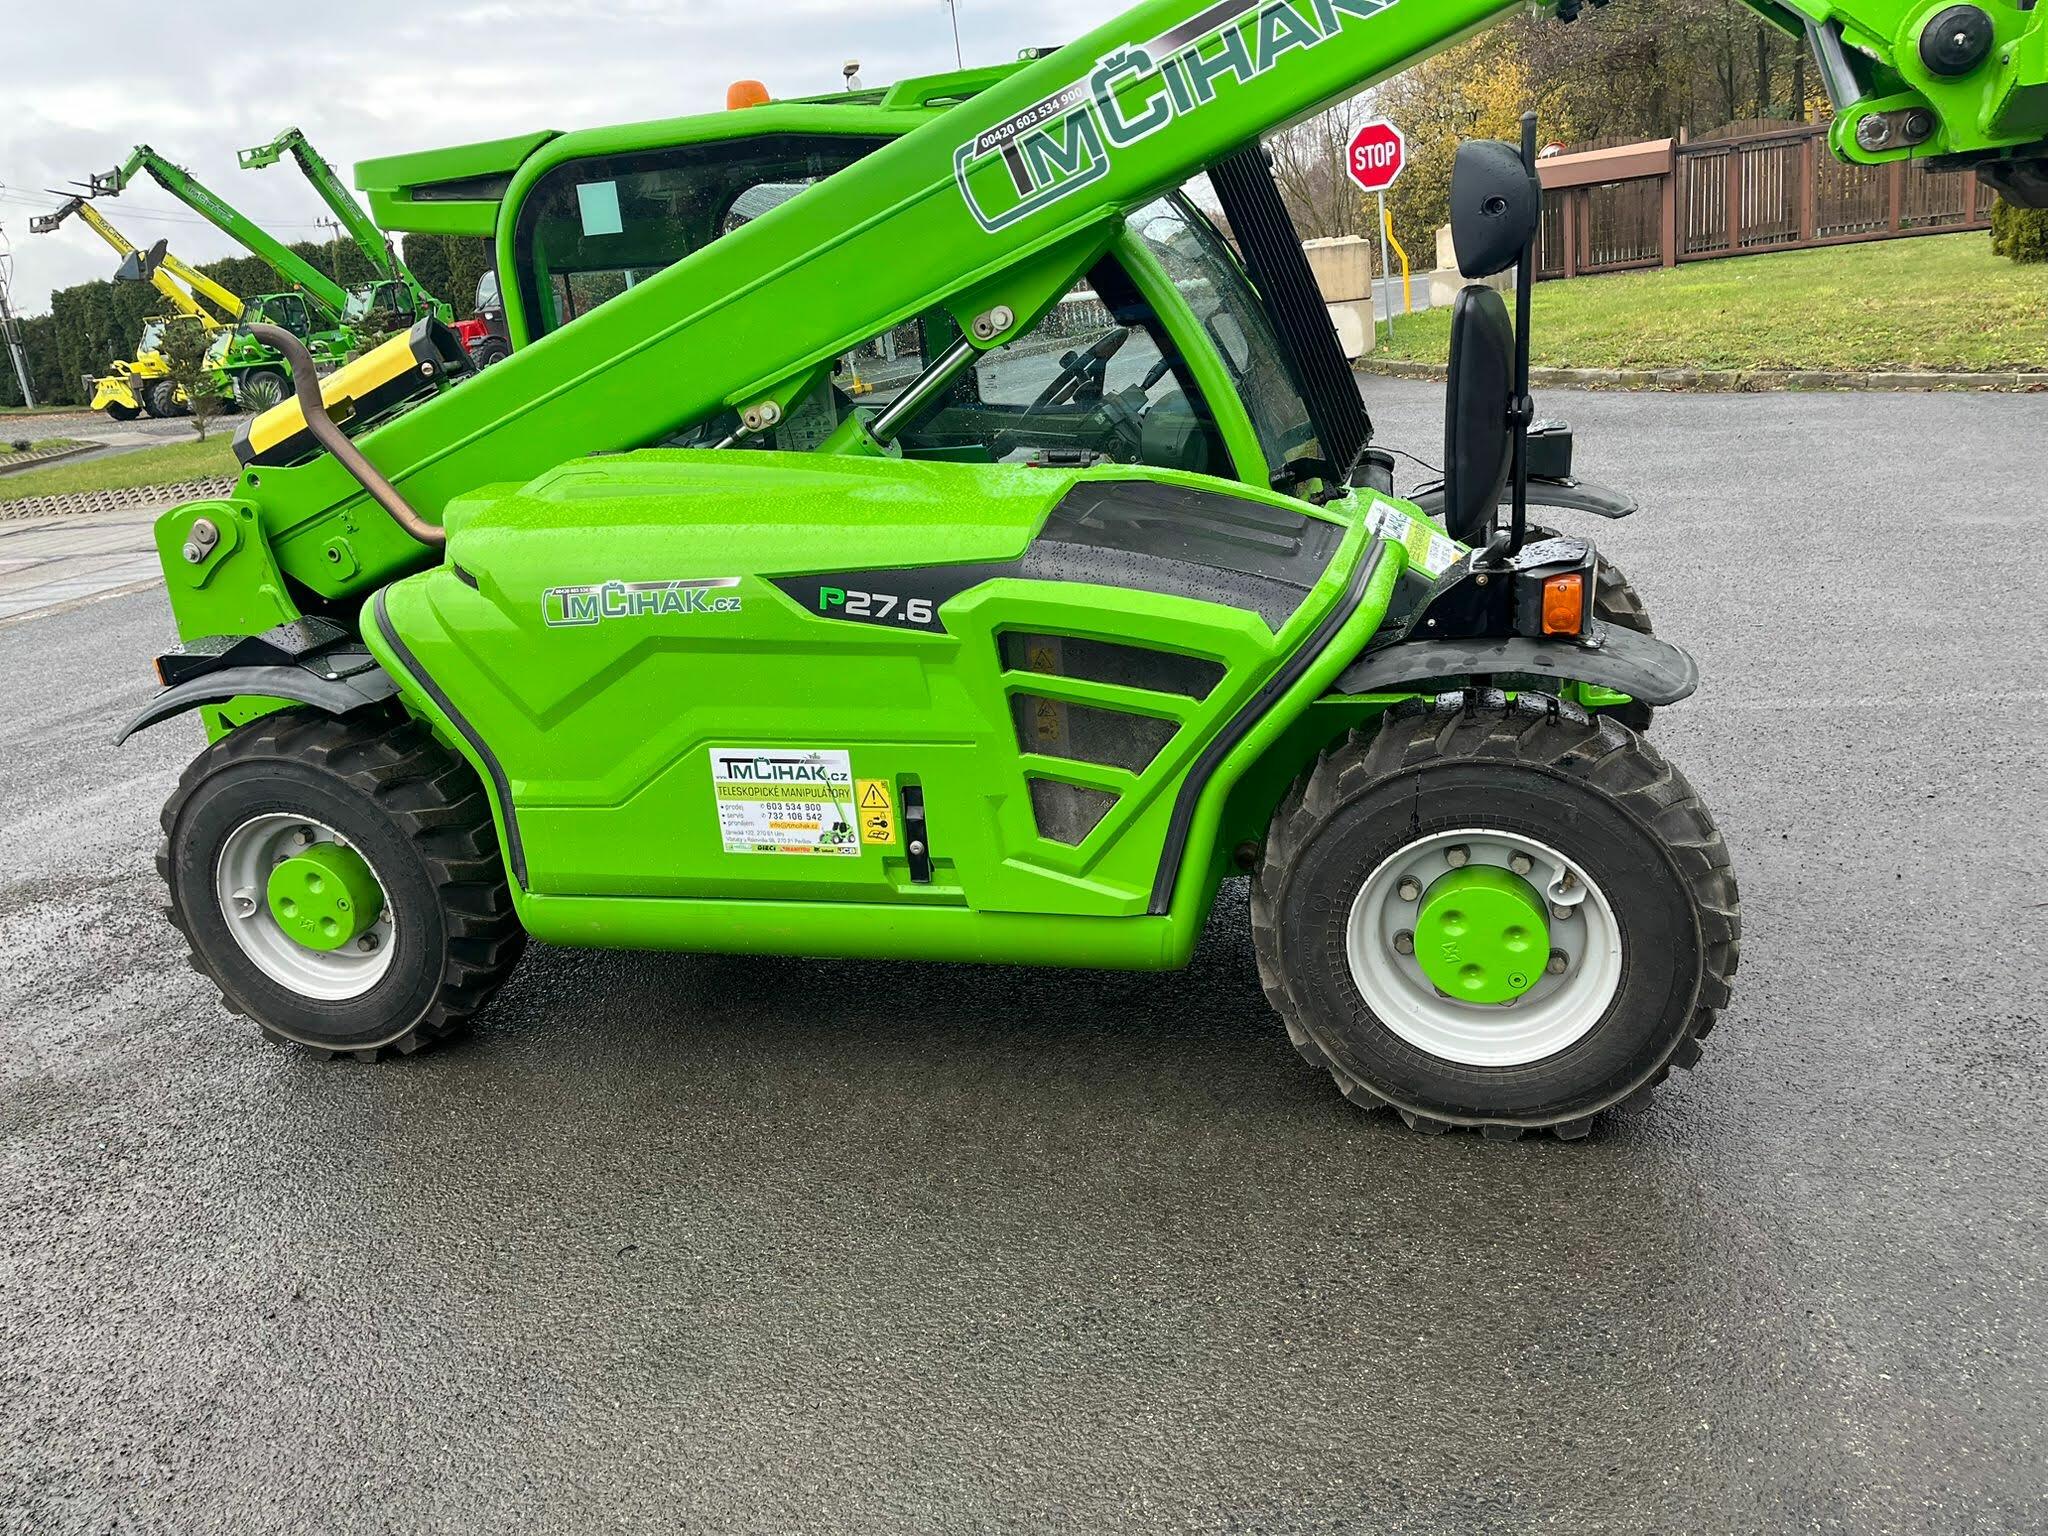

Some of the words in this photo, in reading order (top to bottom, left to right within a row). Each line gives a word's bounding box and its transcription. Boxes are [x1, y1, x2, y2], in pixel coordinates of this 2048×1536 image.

[980, 123, 1015, 149] 00420
[1016, 111, 1038, 130] 603
[1038, 99, 1060, 117] 534
[1060, 86, 1084, 105] 900
[1354, 141, 1396, 171] STOP
[819, 586, 933, 624] P27.6
[718, 785, 779, 797] TELESKOPICKÉ
[781, 786, 850, 799] MANIPULÁTORY
[766, 802, 783, 811] 603
[785, 803, 802, 811] 534
[804, 803, 822, 811] 900
[768, 812, 784, 820] 732
[806, 813, 823, 821] 542
